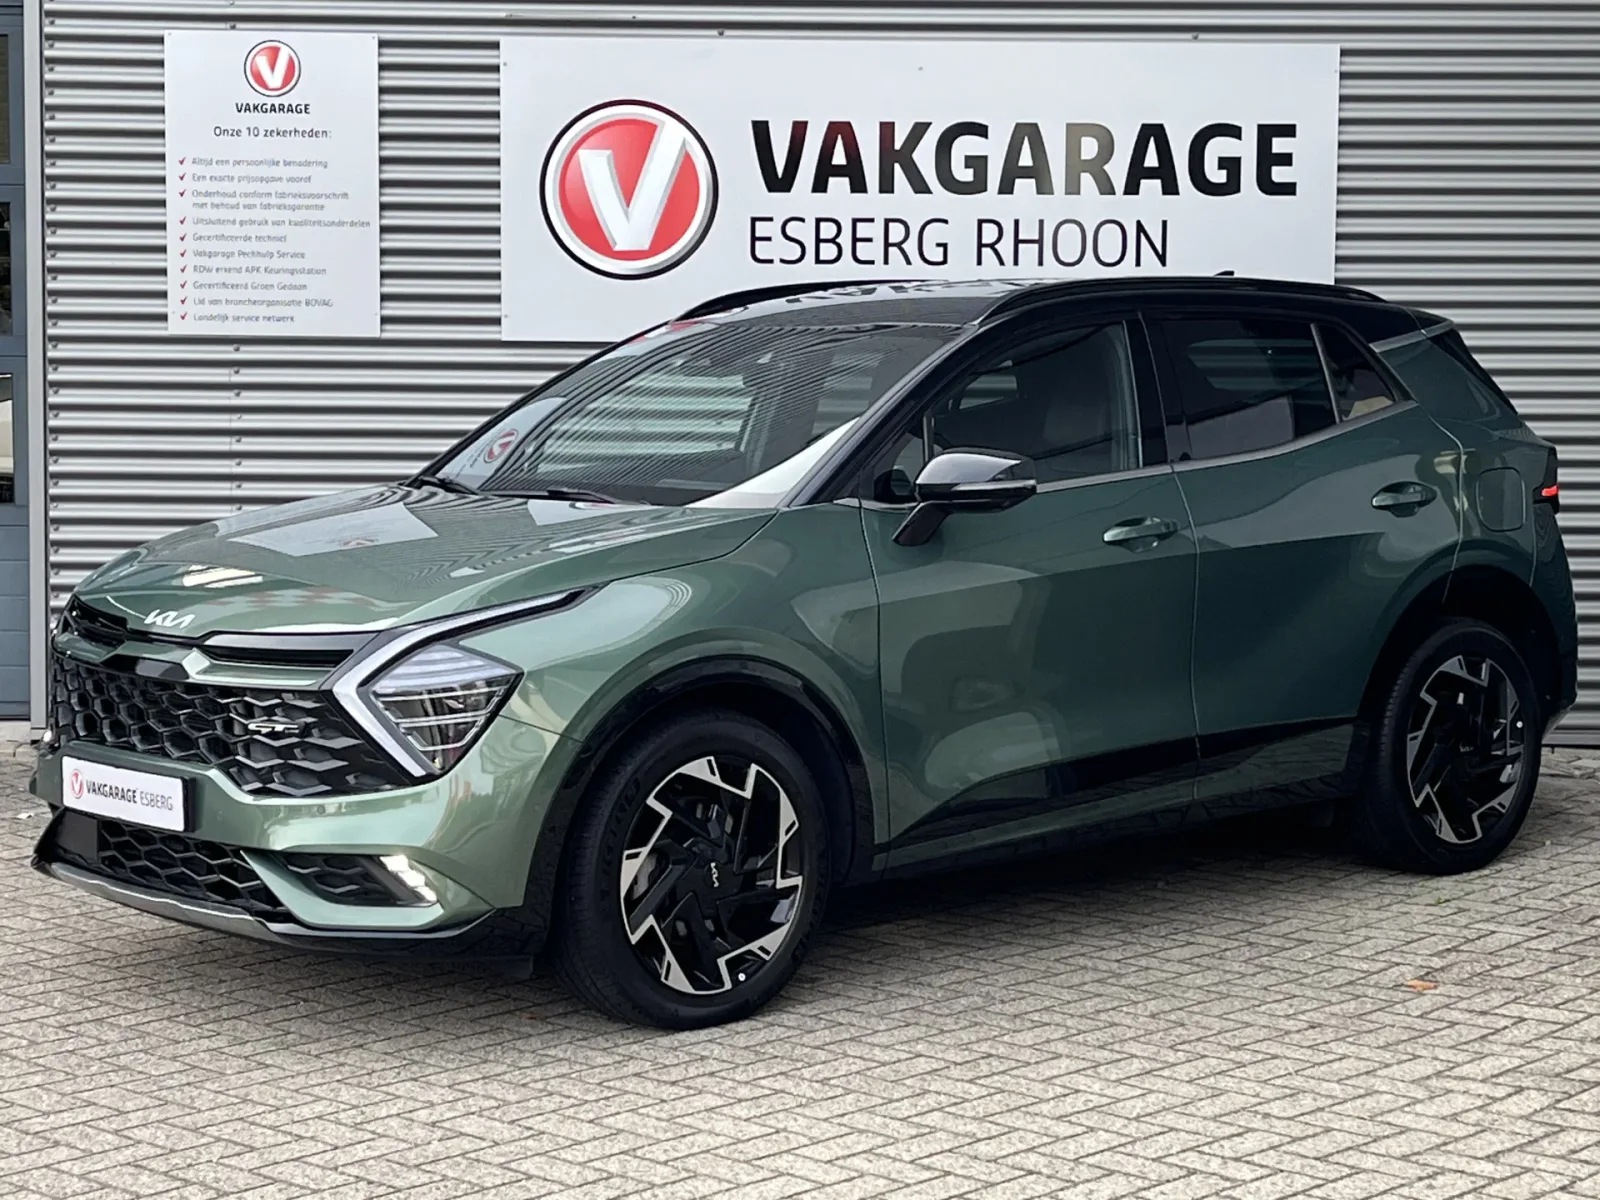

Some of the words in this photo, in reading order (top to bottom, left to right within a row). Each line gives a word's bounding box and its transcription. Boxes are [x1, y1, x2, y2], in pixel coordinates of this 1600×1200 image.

[235, 102, 311, 115] VAKGARAGE
[214, 126, 242, 137] Onze
[247, 127, 259, 137] 10
[263, 127, 332, 139] zekerheden:
[216, 158, 230, 166] een
[233, 158, 280, 168] persoonlijke
[283, 159, 328, 168] benadering
[751, 120, 1297, 197] VAKGARAGE
[192, 174, 206, 182] Een
[209, 174, 234, 182] exacte
[237, 175, 284, 184] prijsopgave
[286, 175, 312, 183] vooraf
[192, 190, 236, 198] Onderhoud
[239, 191, 272, 199] conform
[192, 202, 207, 210] met
[210, 202, 239, 210] behoud
[239, 218, 269, 228] gebruik
[271, 219, 285, 227] van
[192, 234, 252, 242] Gecertificeerde
[750, 217, 949, 266] ESBERG
[977, 219, 1168, 268] RHOON
[277, 250, 305, 259] Service
[193, 266, 212, 274] RDW
[216, 266, 242, 274] erkend
[245, 266, 261, 274] APK
[264, 267, 327, 276] Keuringsstation
[193, 282, 248, 290] Gecertificeerd
[250, 282, 274, 291] Groen
[277, 282, 307, 291] Gedaan
[208, 298, 222, 306] van
[305, 299, 333, 307] BOVAG
[193, 313, 229, 323] Landelijk
[232, 314, 260, 322] service
[263, 314, 295, 322] netwerk
[86, 780, 137, 804] VAKGARAGE
[139, 790, 173, 810] ESBERG
